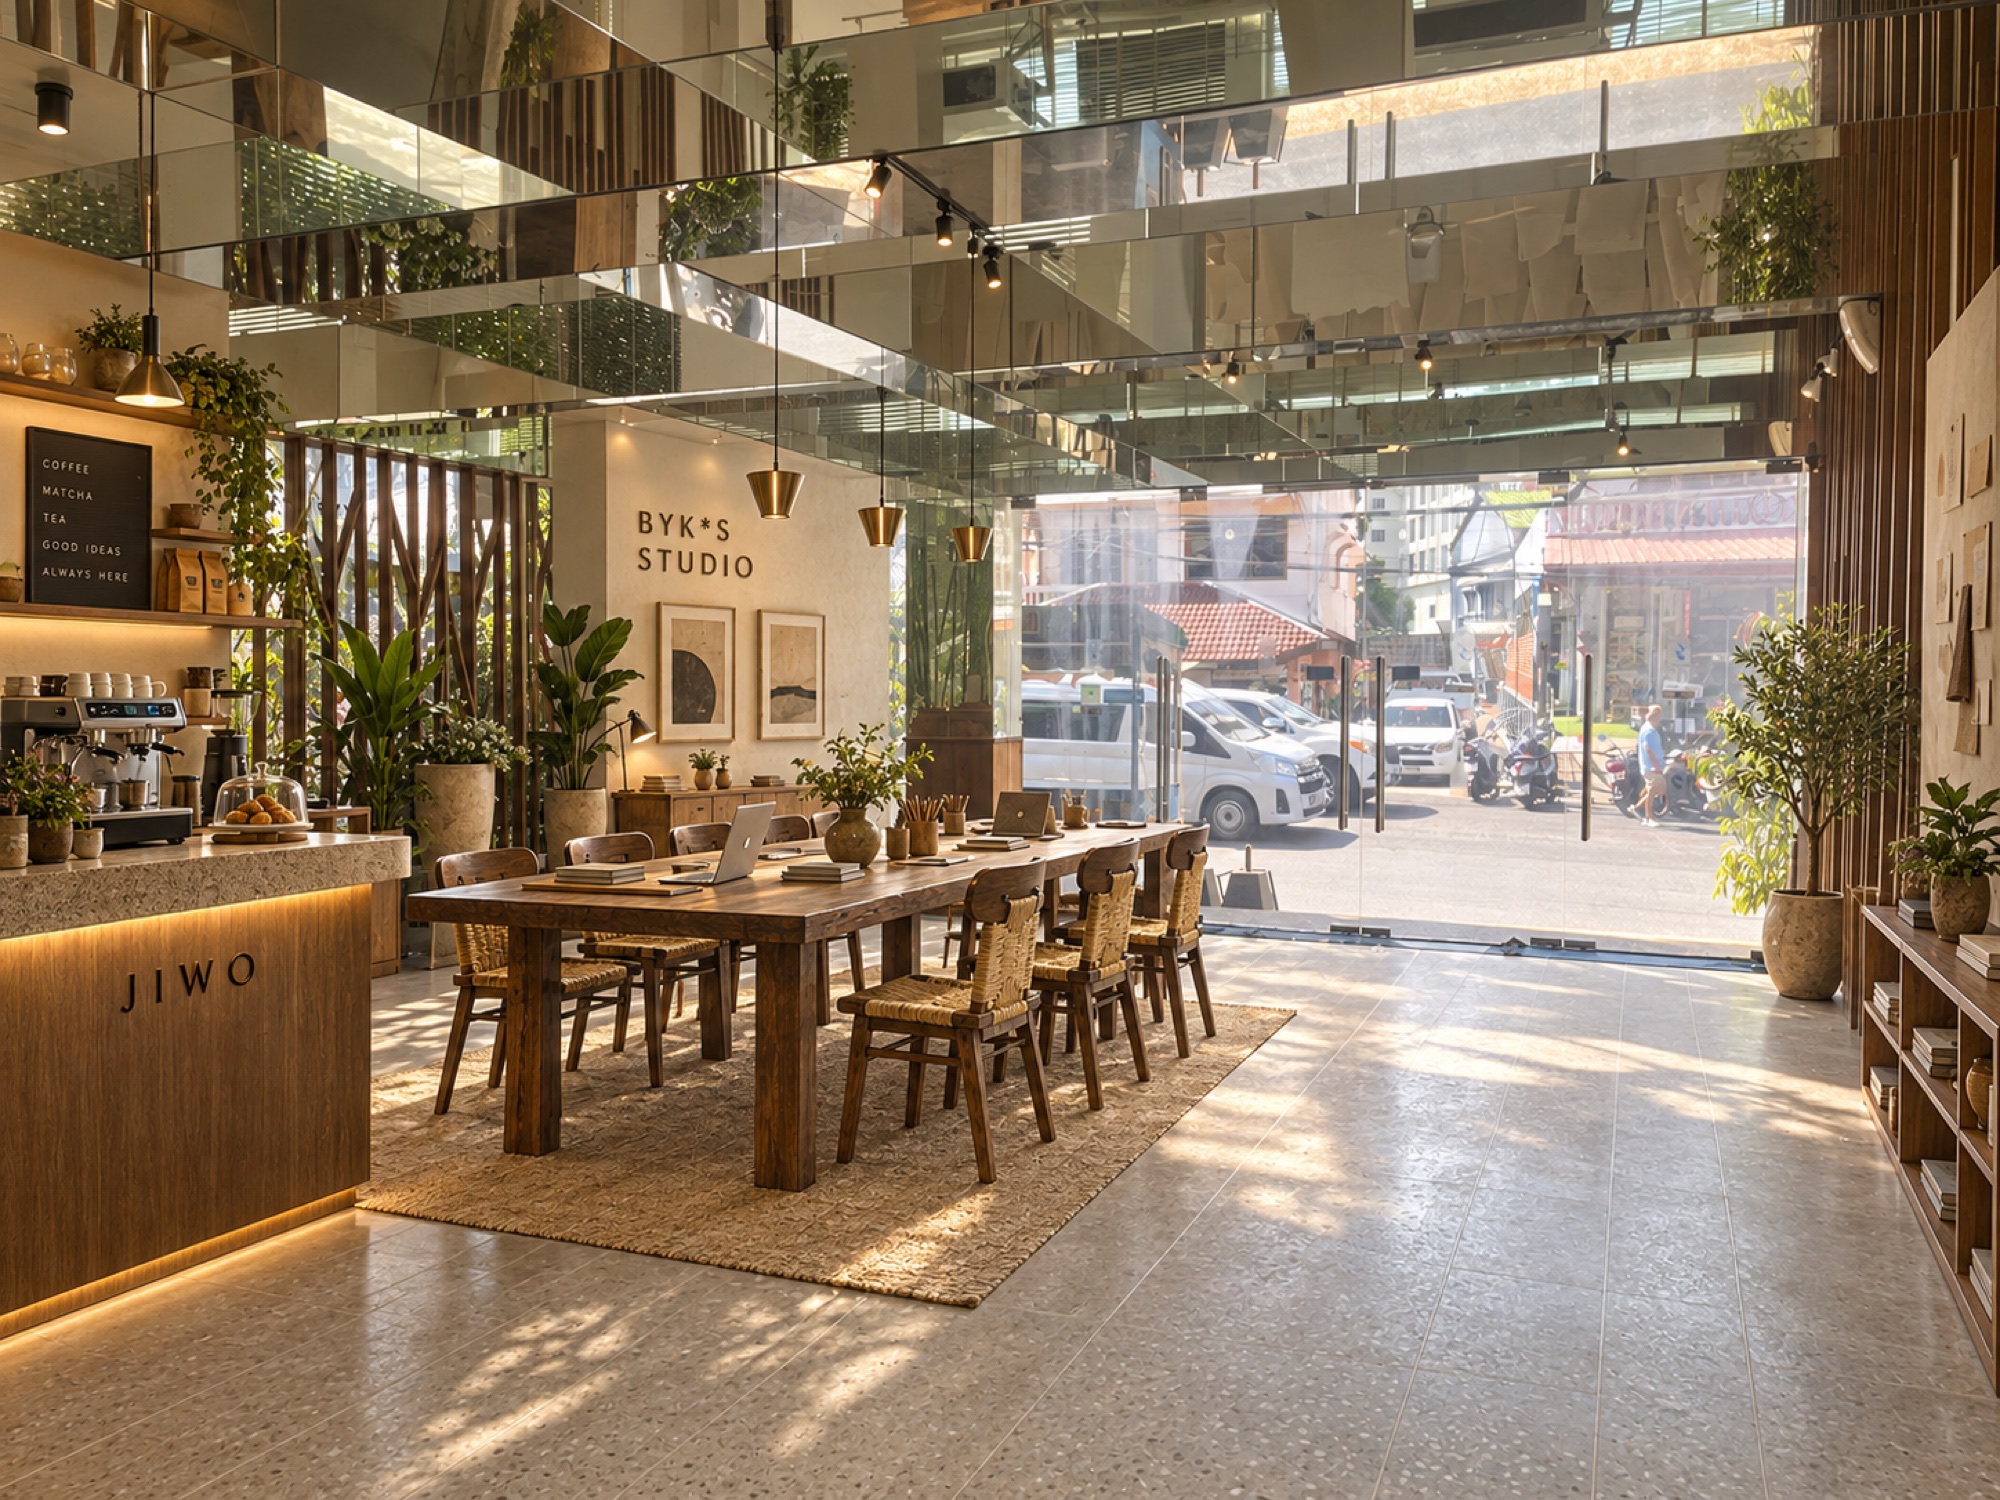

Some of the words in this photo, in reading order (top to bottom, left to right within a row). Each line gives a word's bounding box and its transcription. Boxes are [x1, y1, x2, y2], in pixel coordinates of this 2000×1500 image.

[42, 458, 90, 475] COFFEE
[42, 485, 94, 501] MATCHA
[42, 512, 67, 525] TEA
[42, 539, 79, 552] GOOD
[85, 544, 122, 557] IDEAS
[637, 546, 754, 579] STUDIO
[41, 567, 92, 580] ALWAYS
[98, 571, 129, 584] HERE
[119, 952, 256, 1014] JIWO
